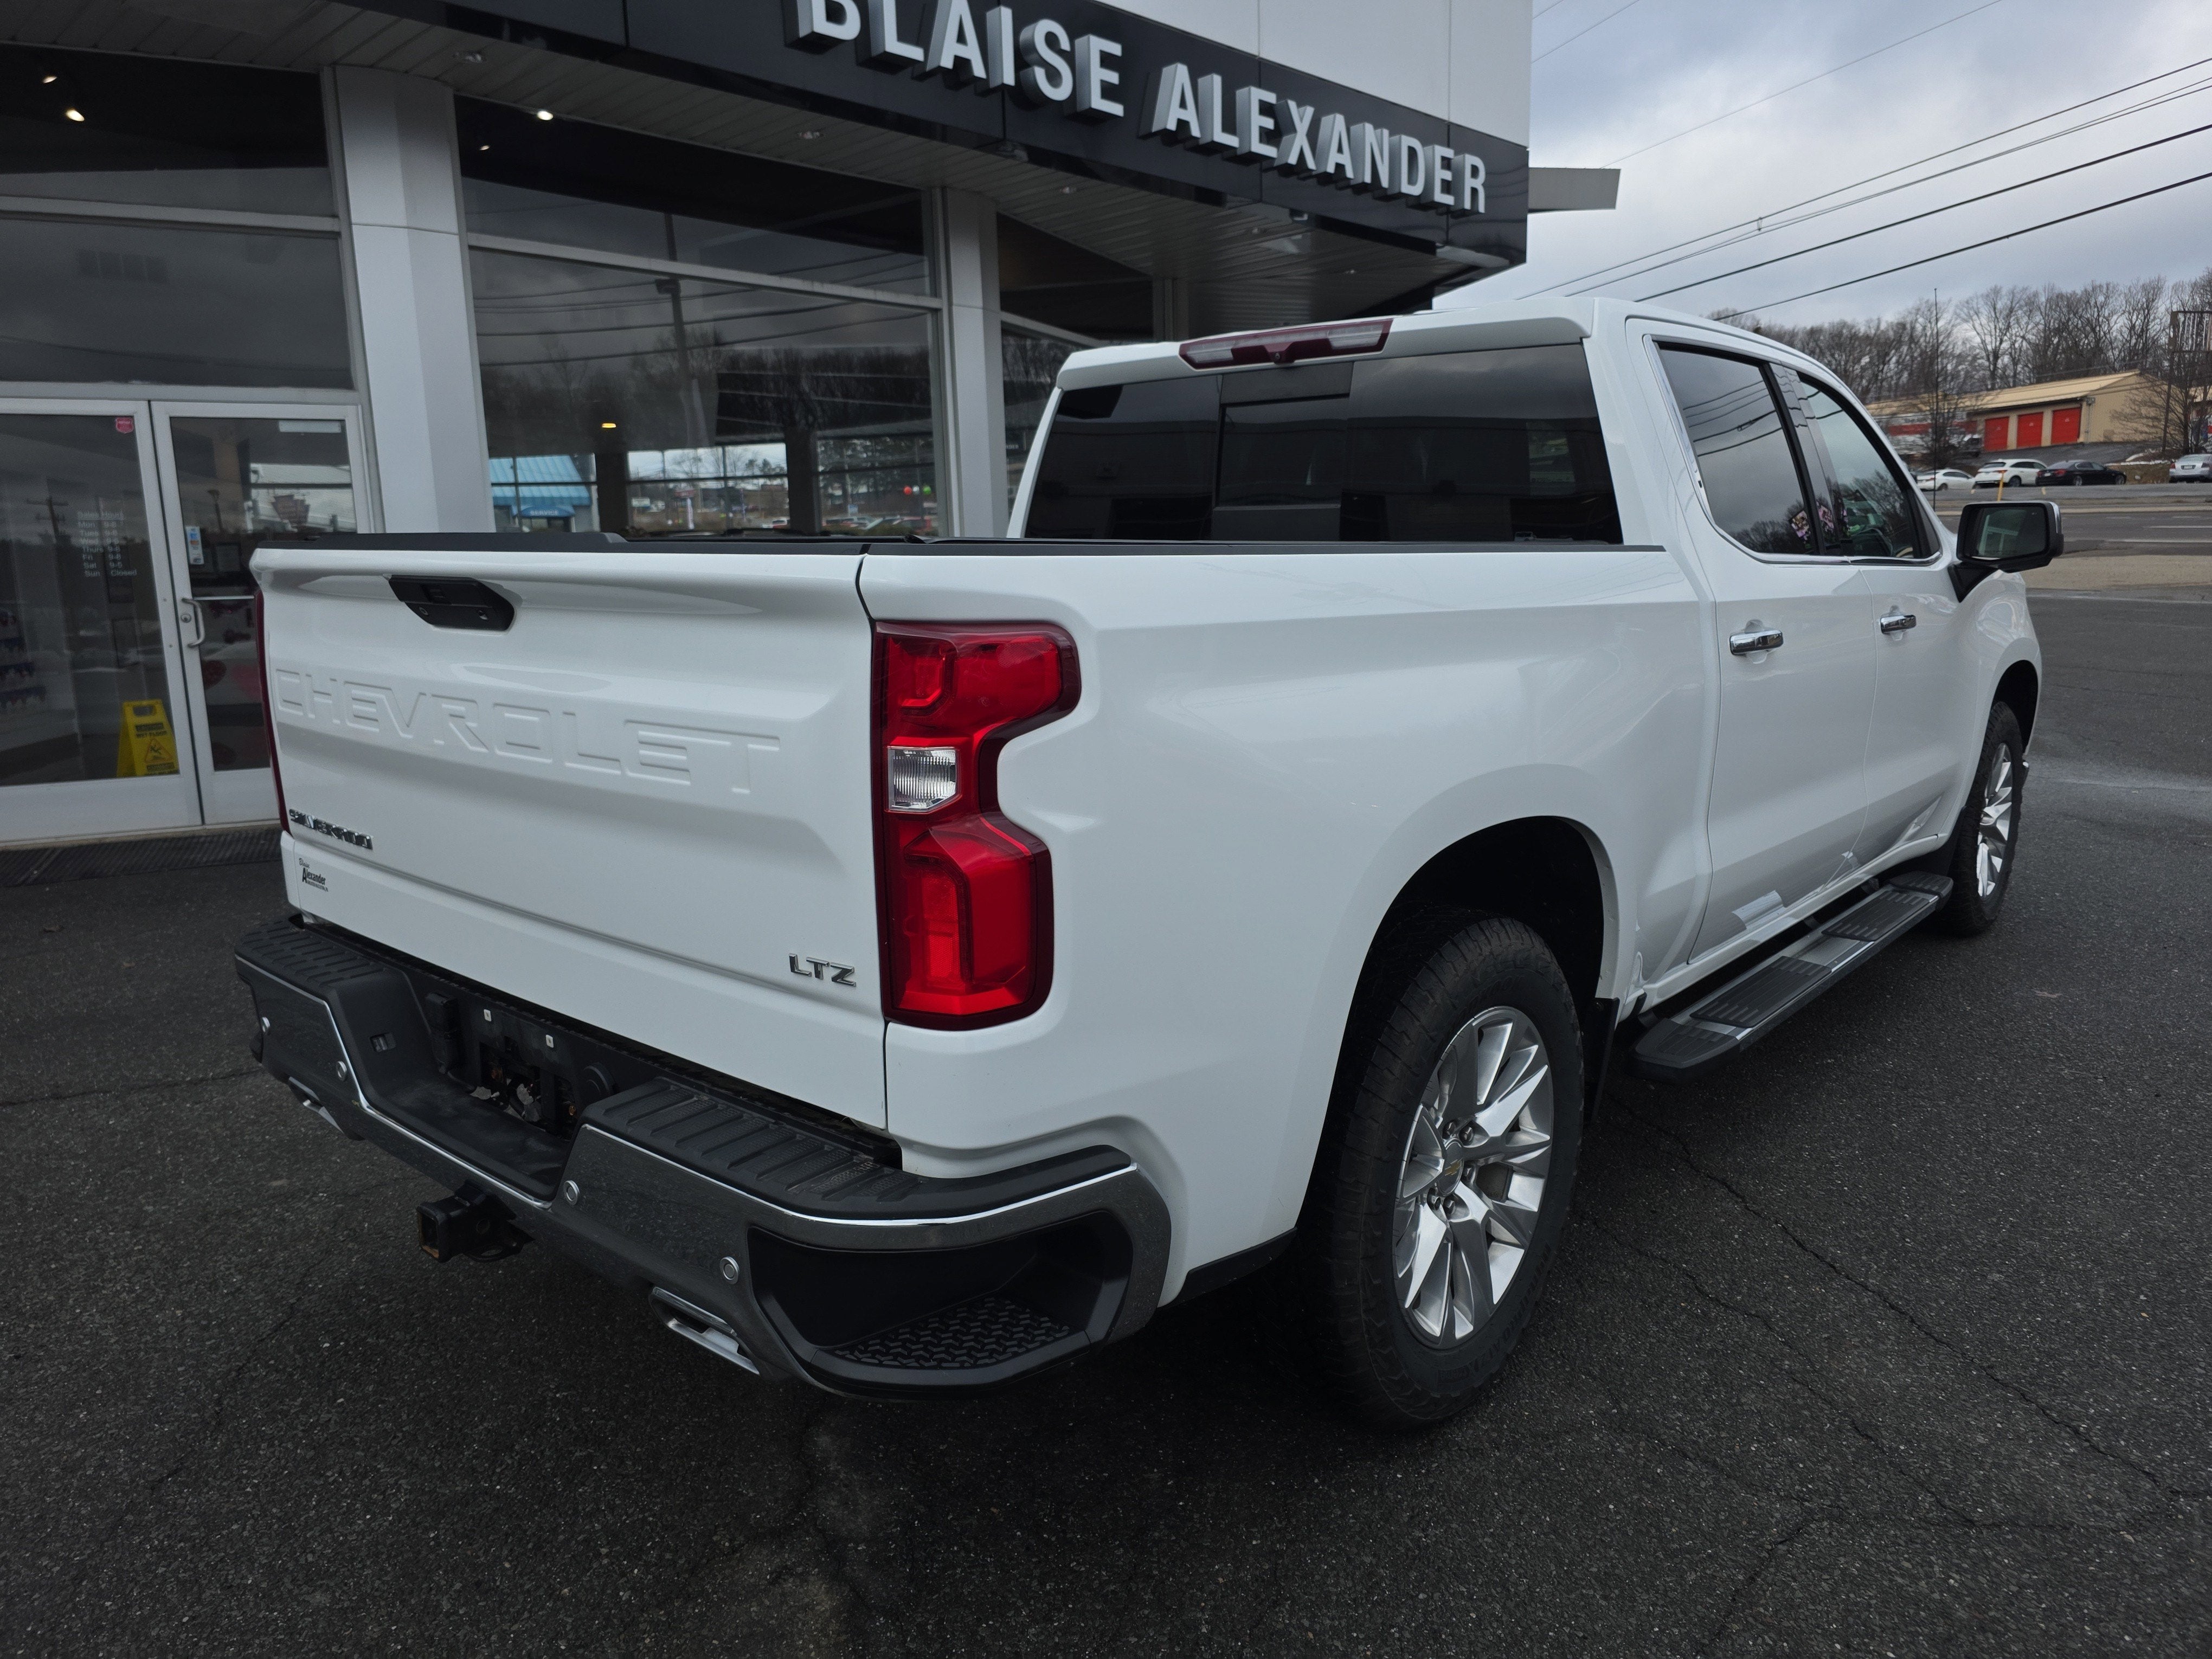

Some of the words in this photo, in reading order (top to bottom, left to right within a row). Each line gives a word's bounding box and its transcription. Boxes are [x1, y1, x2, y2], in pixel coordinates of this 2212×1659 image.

[1152, 62, 1486, 214] ALEXANDER
[78, 511, 99, 519] Sales
[100, 511, 124, 519] Hours
[111, 569, 138, 577] Closed
[275, 668, 780, 795] CHEVROLET
[289, 808, 373, 851] SILVERADO
[302, 867, 326, 885] Alexander
[789, 953, 856, 987] LTZ
